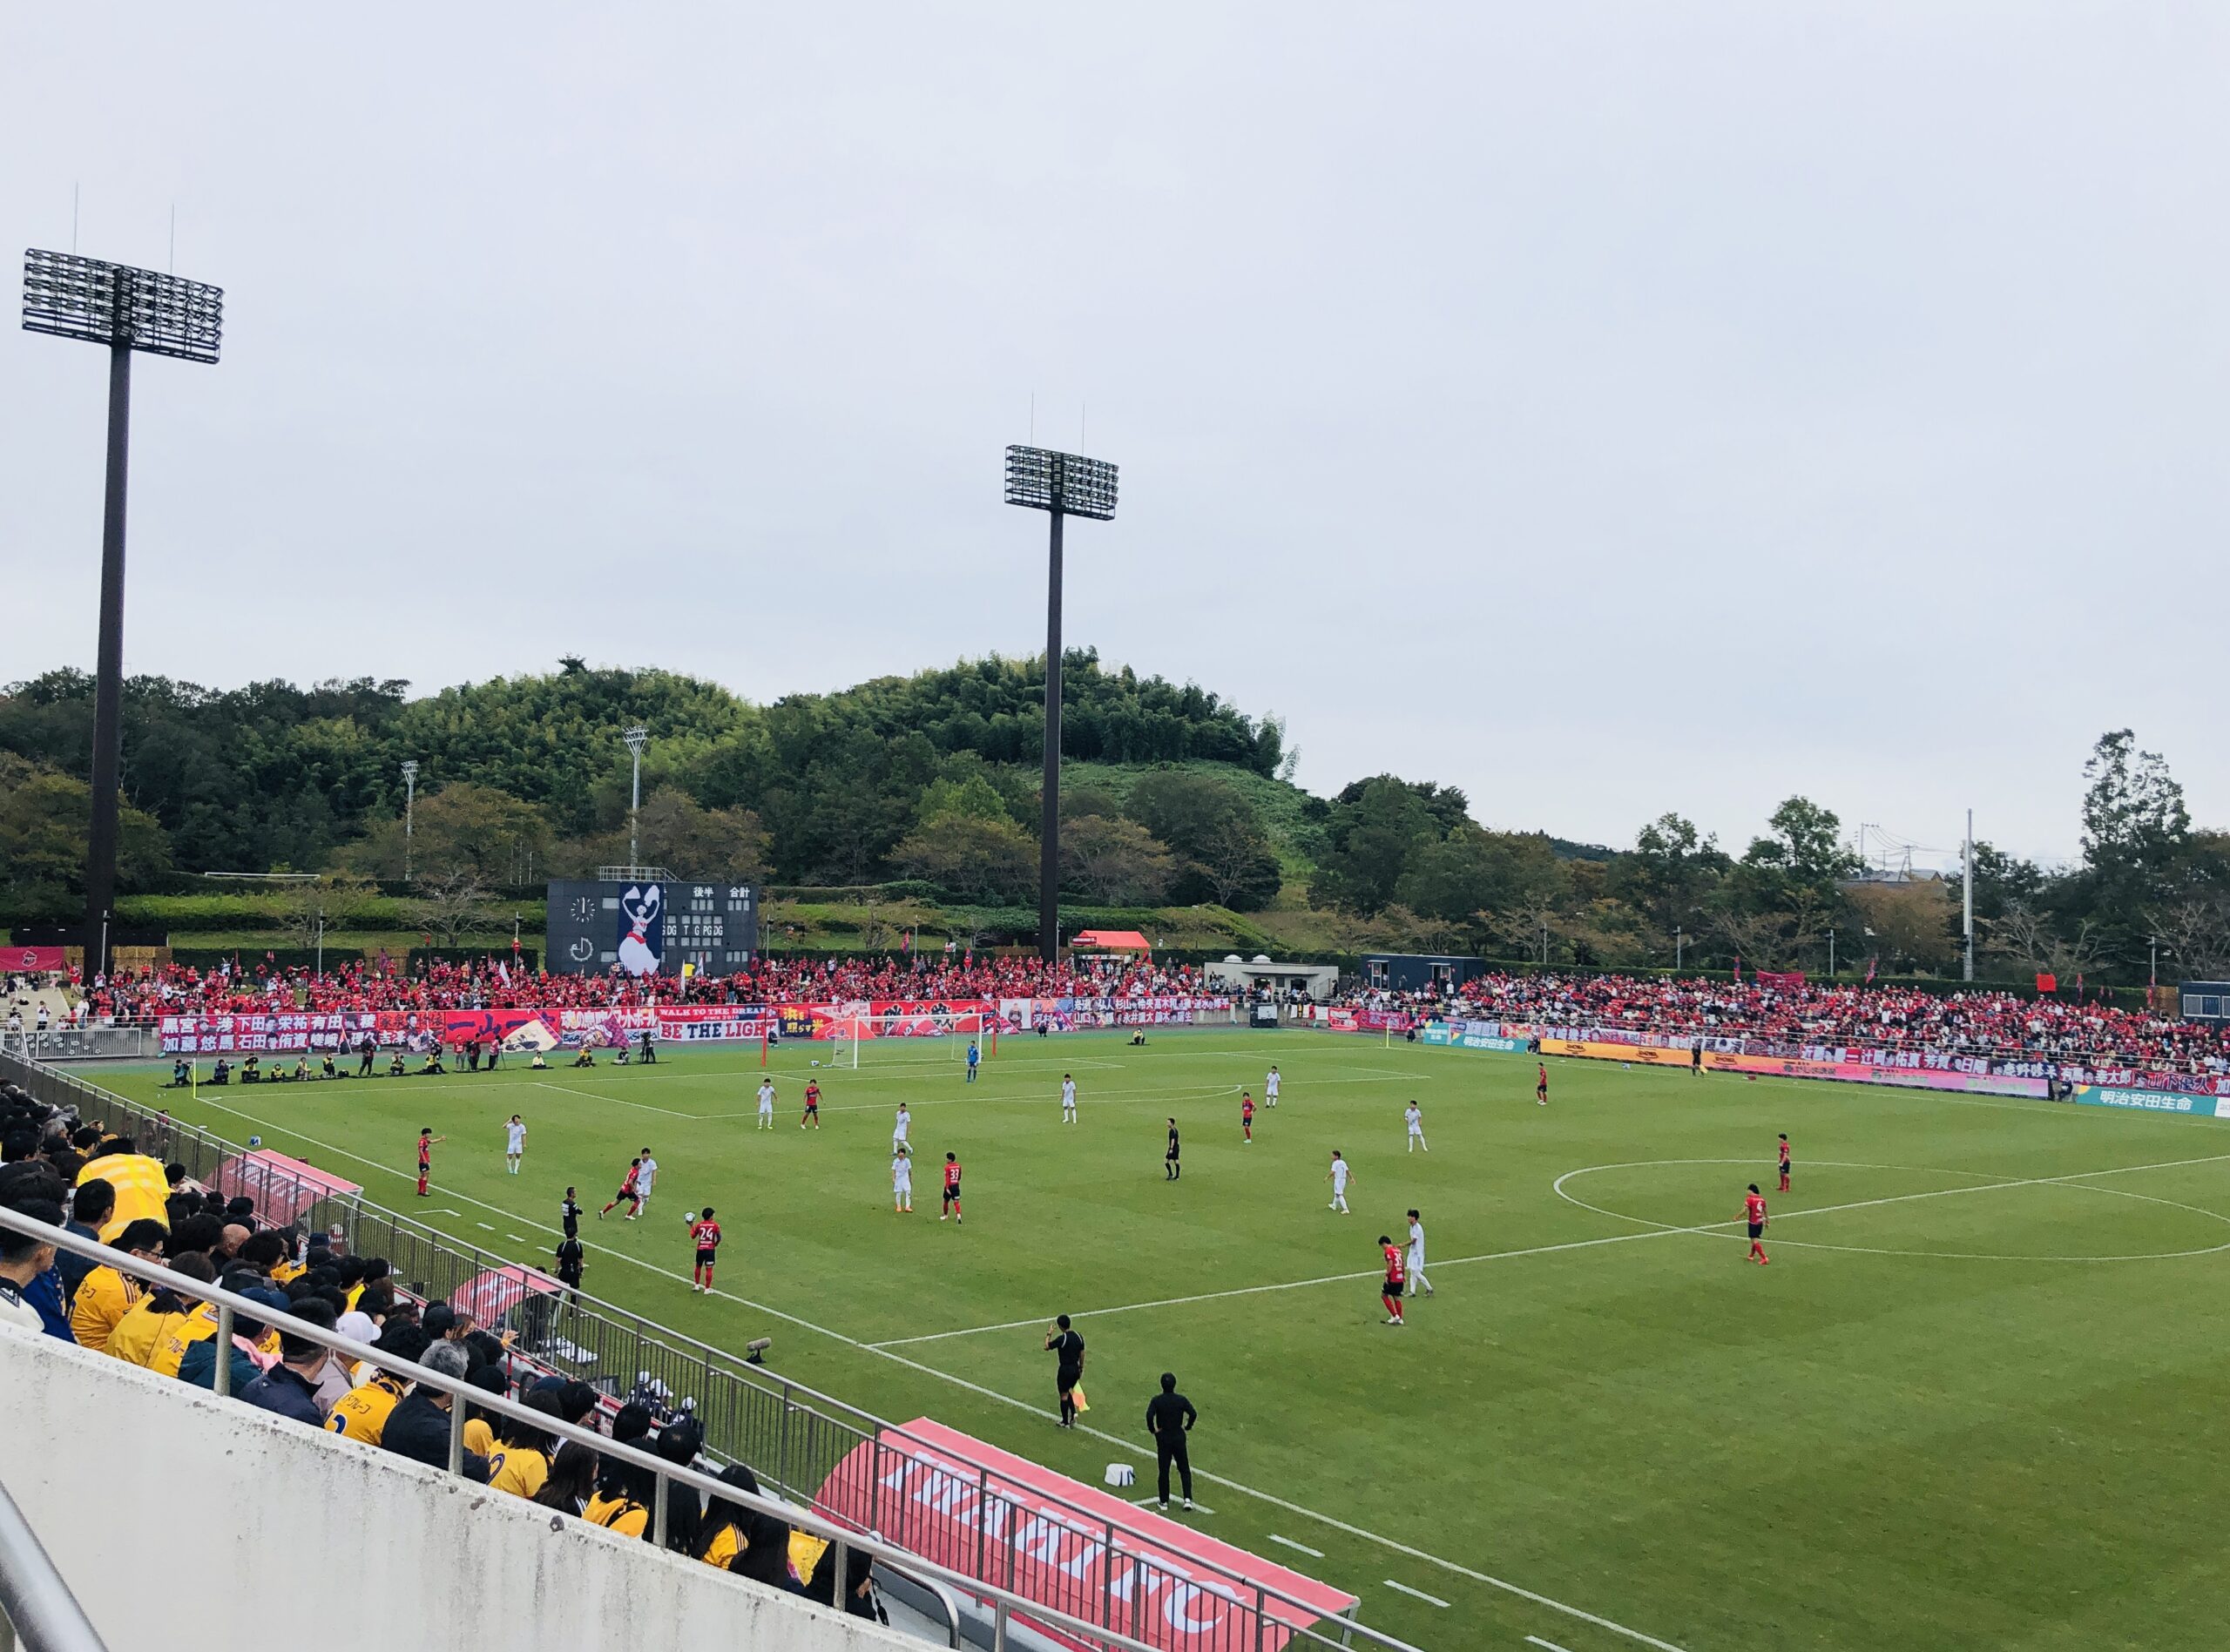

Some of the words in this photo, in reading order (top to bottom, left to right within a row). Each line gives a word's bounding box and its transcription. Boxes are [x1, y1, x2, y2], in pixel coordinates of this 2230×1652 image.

[693, 887, 714, 897] 後半
[729, 887, 750, 898] 合計
[666, 926, 677, 935] DG
[684, 926, 688, 935] T
[694, 926, 700, 935] G
[703, 926, 713, 935] PG
[713, 926, 723, 935] DG
[661, 1024, 683, 1039] BE
[687, 1022, 722, 1038] THE
[2099, 1090, 2193, 1111] 明治安田生命
[949, 1169, 960, 1180] 33
[699, 1227, 713, 1240] 24
[879, 1450, 1127, 1582] IWAKI
[1098, 1550, 1247, 1634] FC
